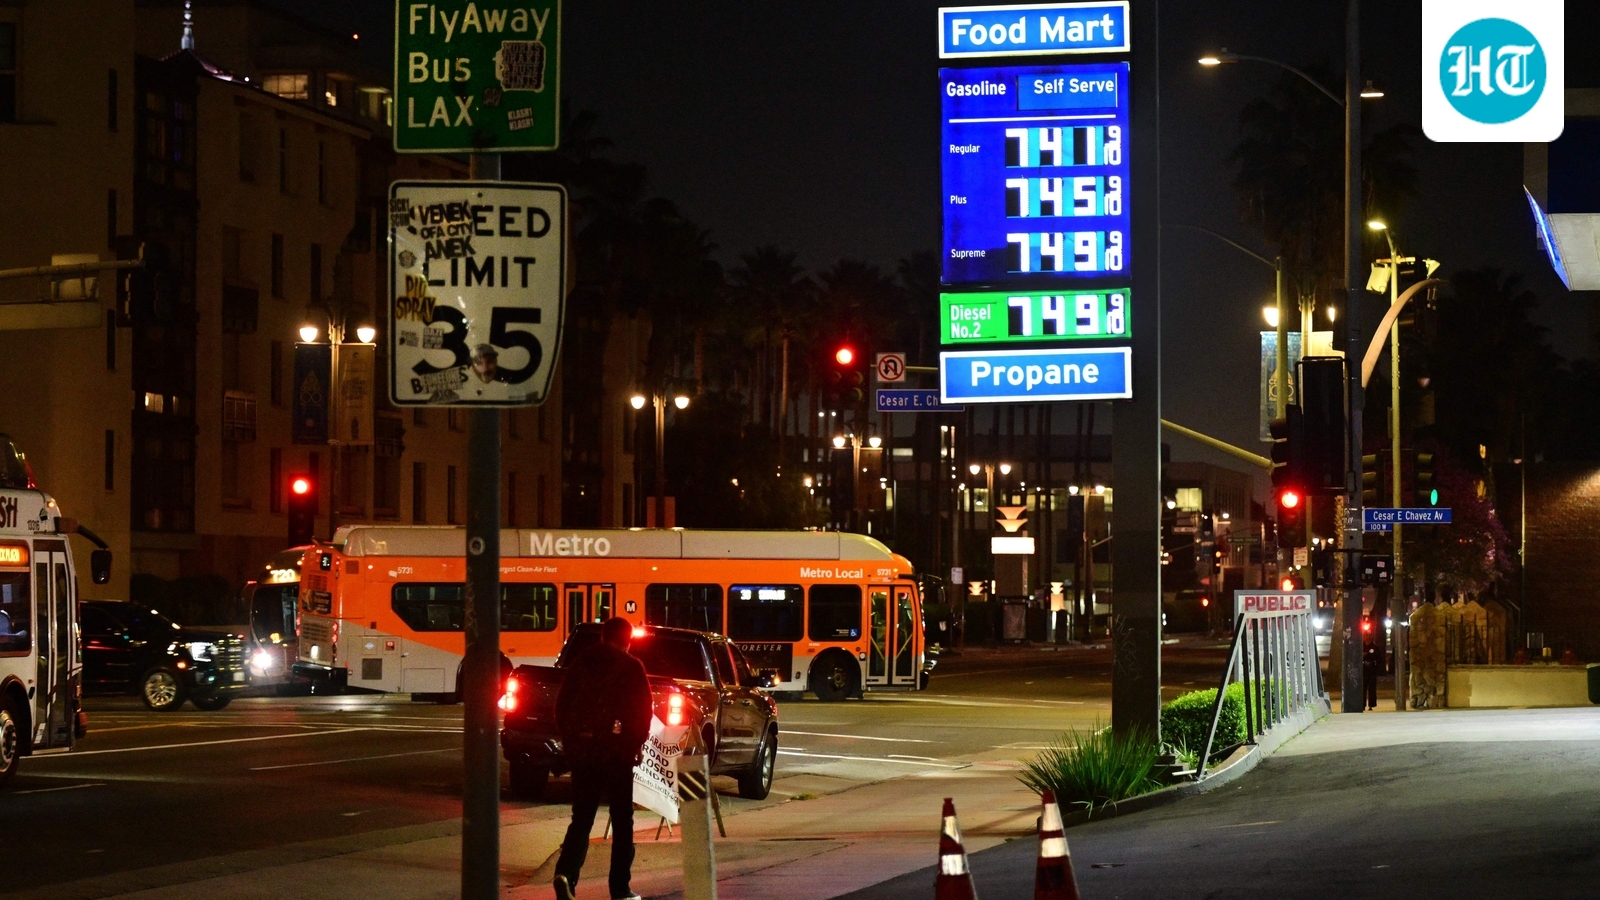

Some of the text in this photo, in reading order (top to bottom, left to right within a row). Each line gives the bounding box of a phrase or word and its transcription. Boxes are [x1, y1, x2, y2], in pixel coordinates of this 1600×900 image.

[409, 2, 550, 43] FlyAway
[951, 13, 1114, 46] Food Mart
[409, 52, 472, 83] Bus
[946, 78, 1114, 97] Gasoline Self Serve
[408, 96, 474, 128] LAX
[949, 144, 980, 155] Regular
[950, 195, 967, 205] Plus
[1005, 176, 1097, 218] 745
[951, 249, 986, 259] Supreme
[1006, 231, 1098, 272] 749
[422, 256, 536, 288] LIMIT
[951, 304, 991, 321] Diesel
[1008, 295, 1099, 337] 749
[951, 322, 981, 338] No.2
[411, 305, 542, 385] 35
[970, 360, 1100, 391] Propane
[879, 395, 939, 406] Cesar E. Ch
[1370, 523, 1381, 531] 100
[1373, 511, 1443, 521] Cesar E Chavez Av
[529, 532, 611, 556] Metro
[270, 569, 296, 583] 720
[397, 566, 413, 575] 5731
[499, 566, 516, 574] argest
[800, 567, 832, 578] Metro
[835, 567, 863, 579] Local
[877, 568, 892, 576] 5731
[1244, 595, 1307, 612] PUBLIC
[642, 744, 670, 767] ROAD
[639, 763, 674, 788] UNDAY
[644, 758, 674, 779] OSED
